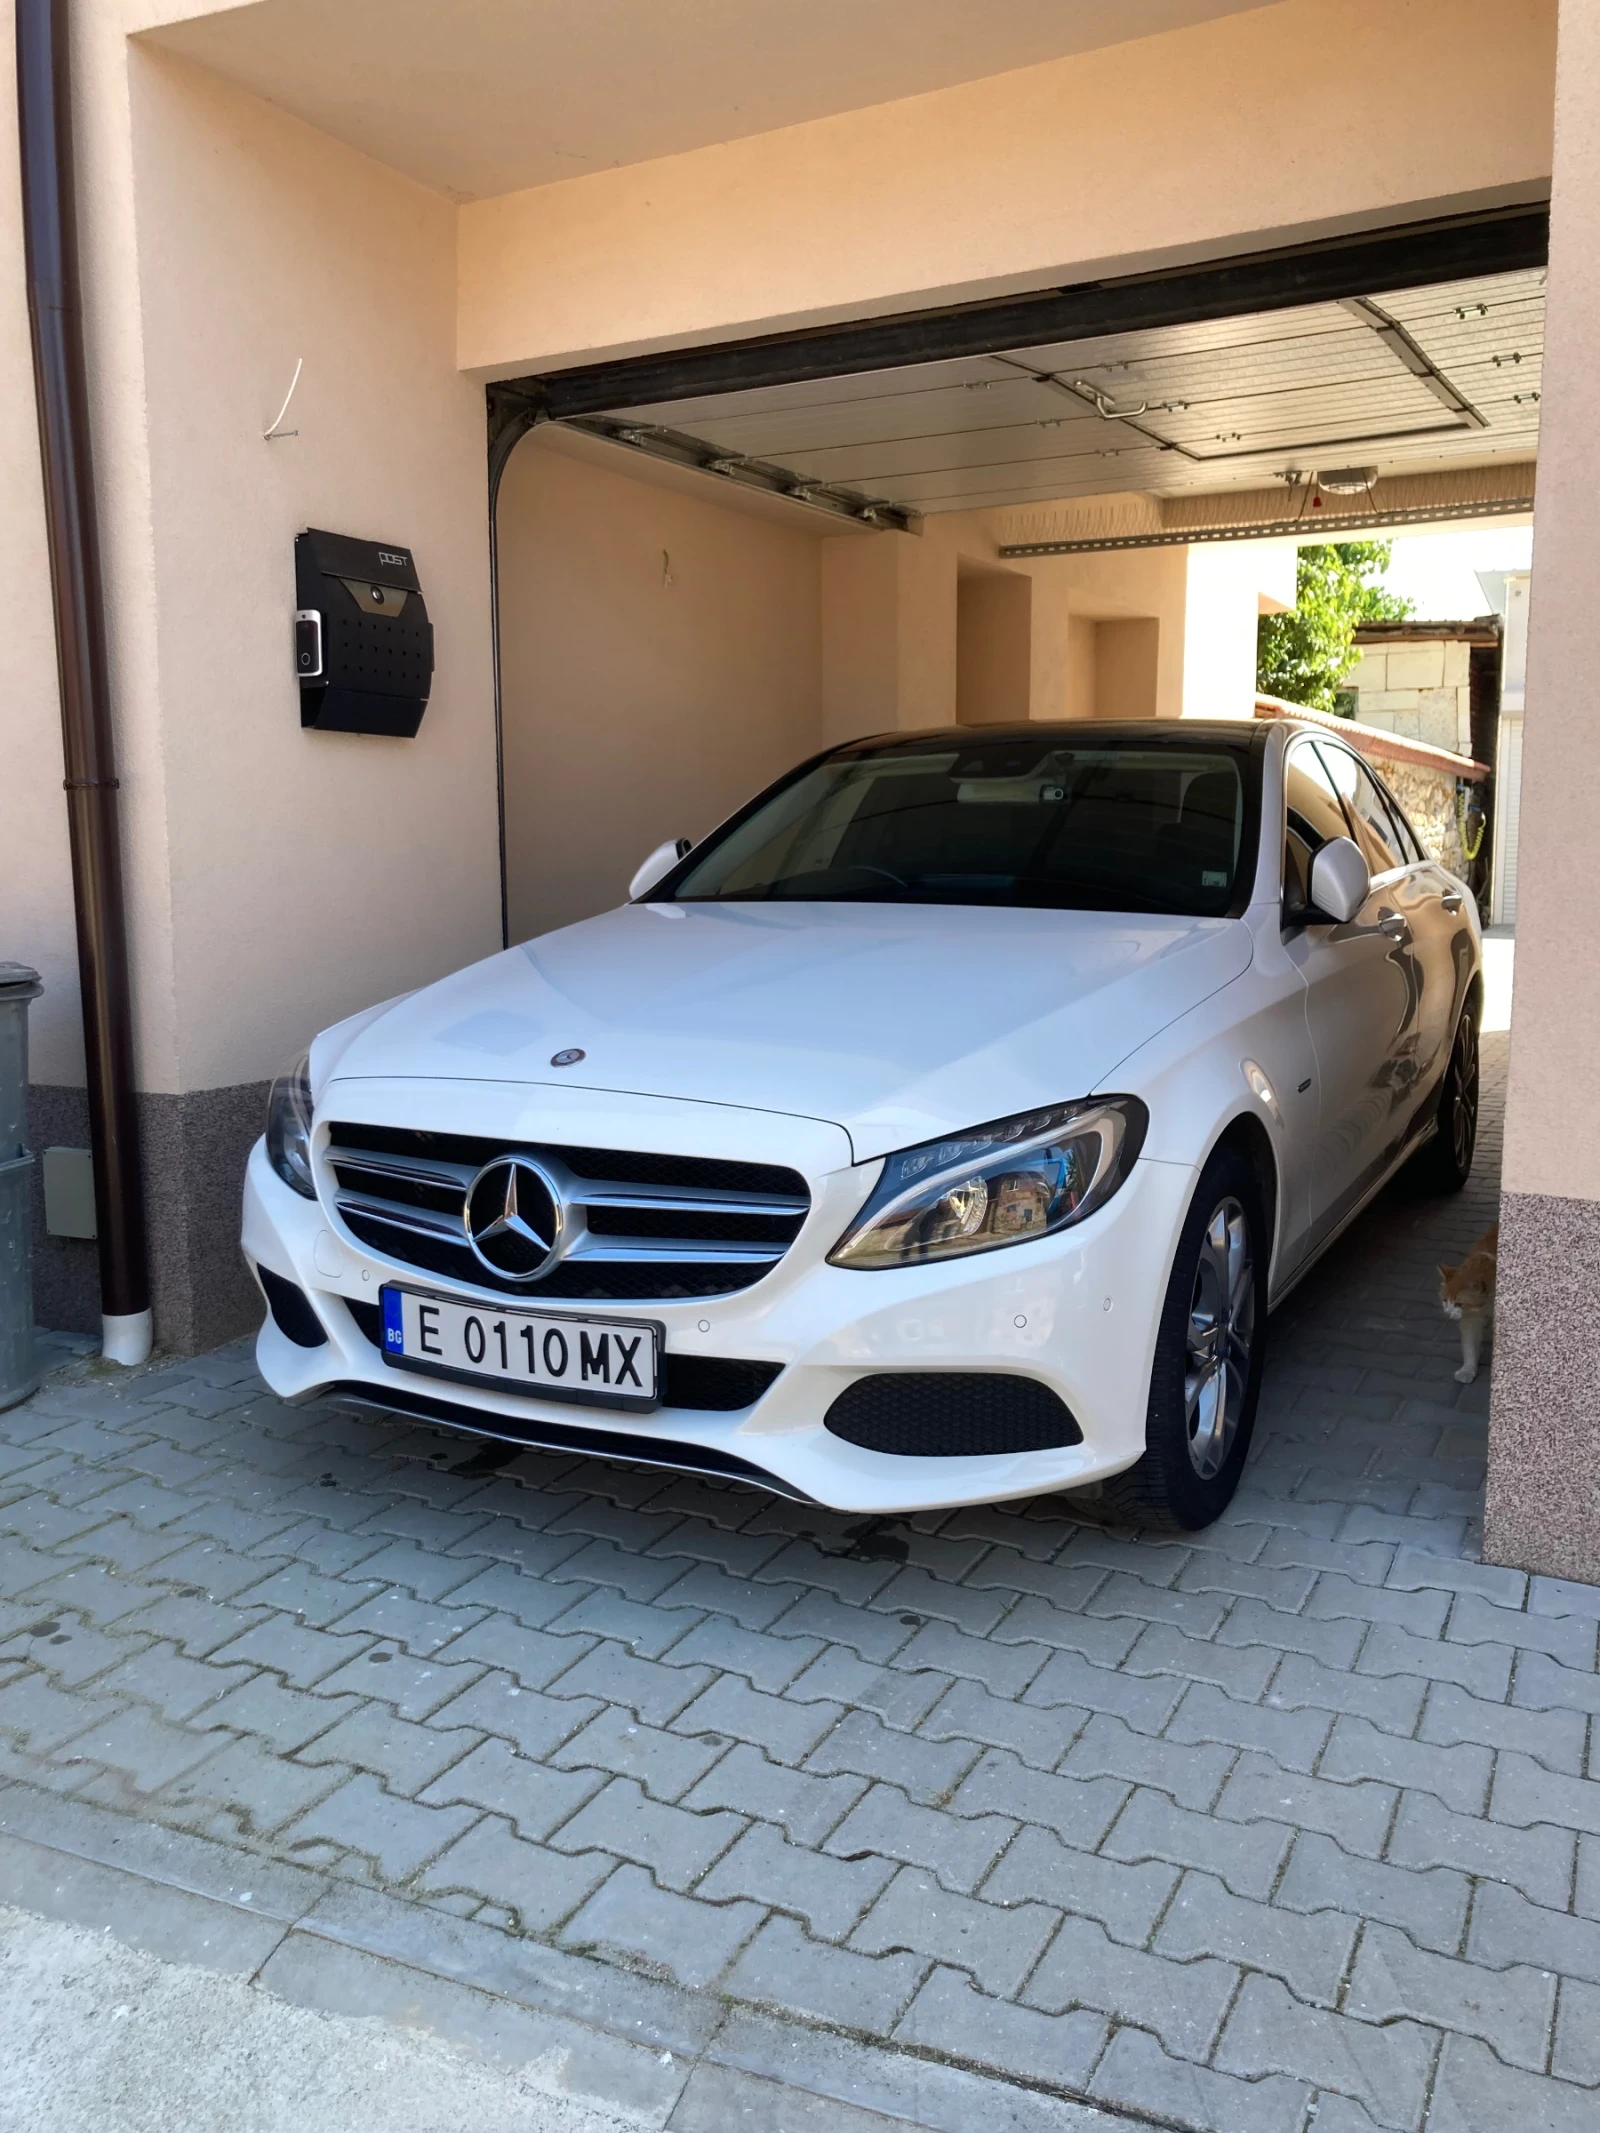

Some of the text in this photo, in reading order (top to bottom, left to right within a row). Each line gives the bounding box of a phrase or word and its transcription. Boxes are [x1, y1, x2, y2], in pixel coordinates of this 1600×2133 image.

[378, 551, 408, 566] POST
[387, 1327, 402, 1344] BG
[419, 1304, 443, 1356] E
